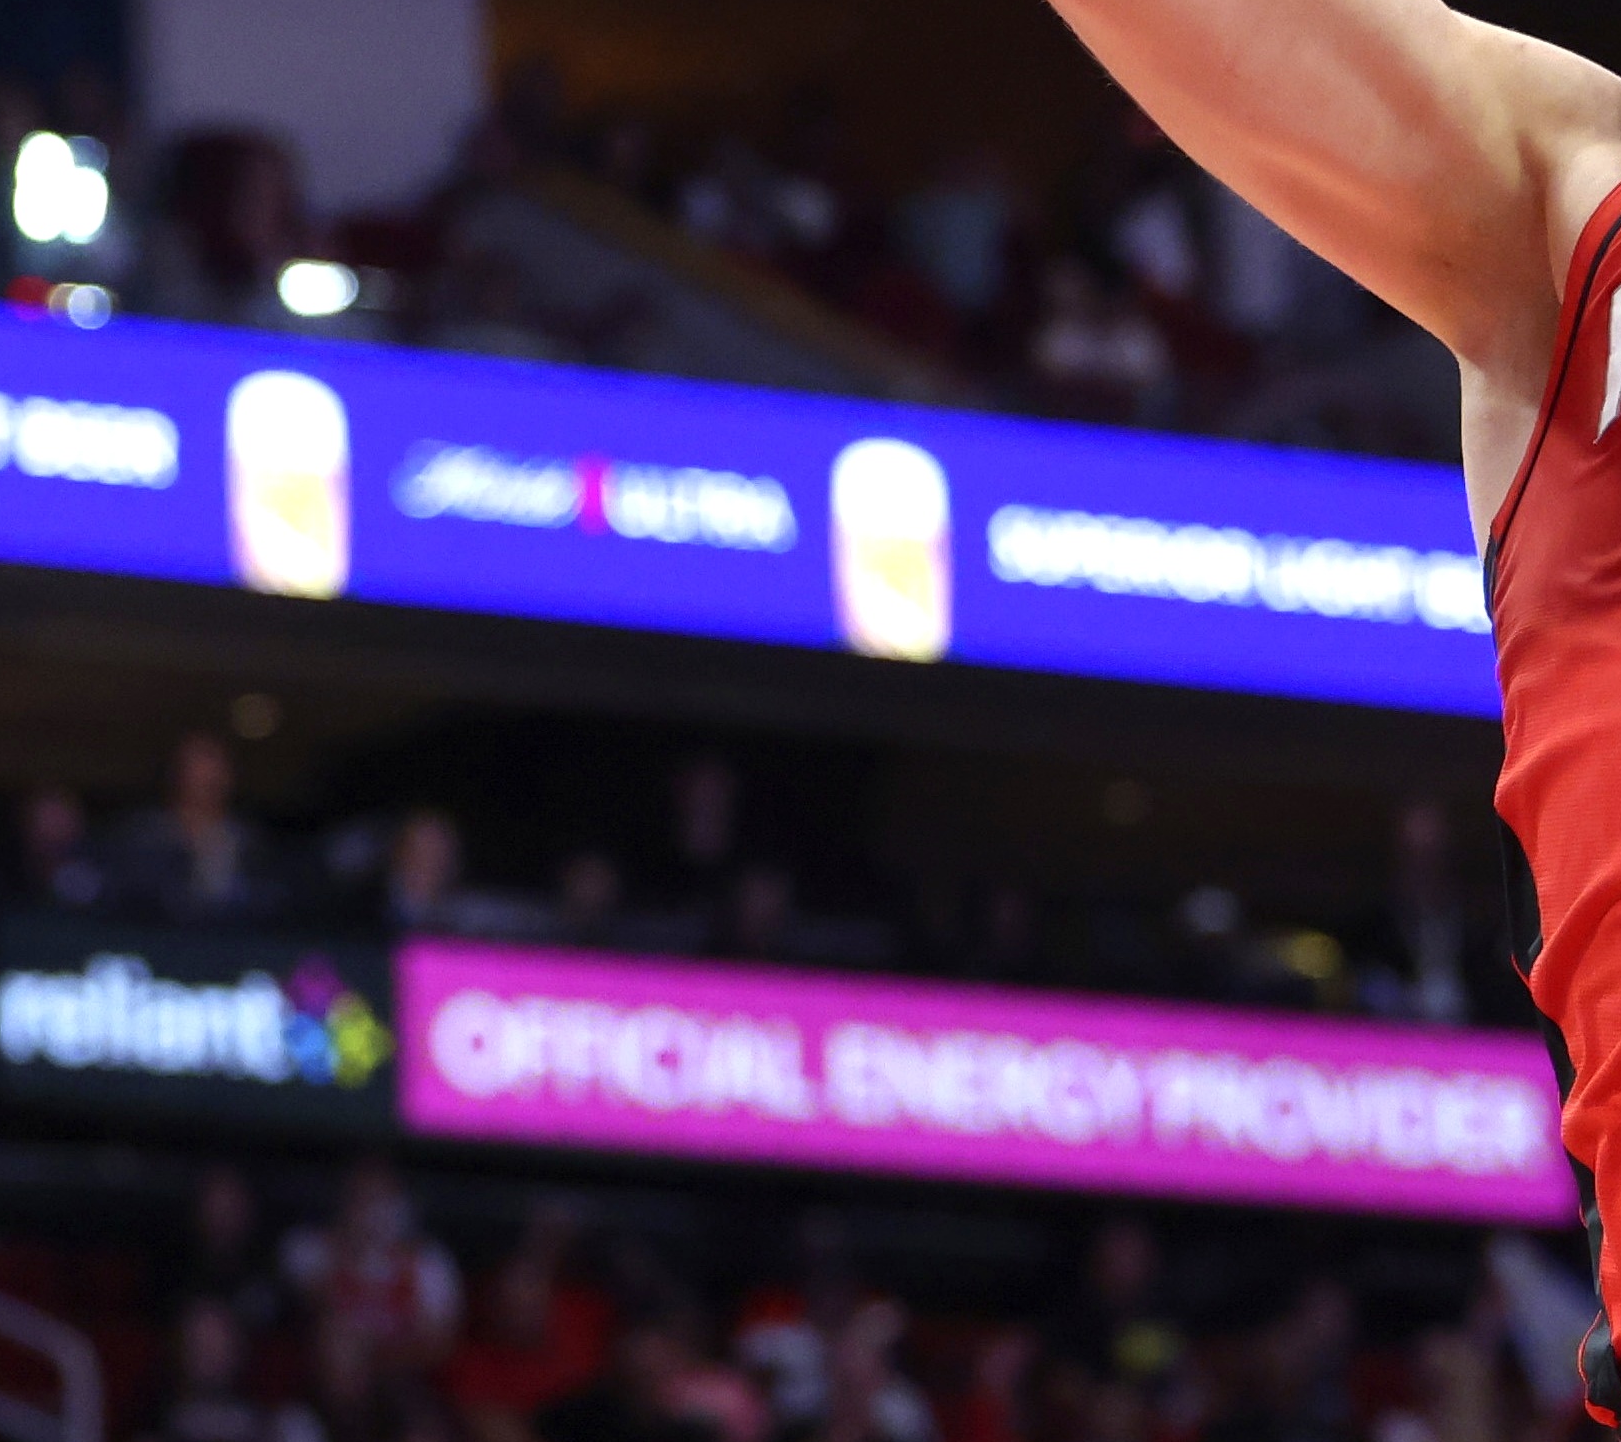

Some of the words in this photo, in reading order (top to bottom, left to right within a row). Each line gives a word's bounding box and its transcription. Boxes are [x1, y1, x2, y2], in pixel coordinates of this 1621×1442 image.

[429, 990, 817, 1120] OFFICIAL
[823, 1022, 1145, 1143] ENERGY
[1149, 1050, 1546, 1175] PROVIDER
